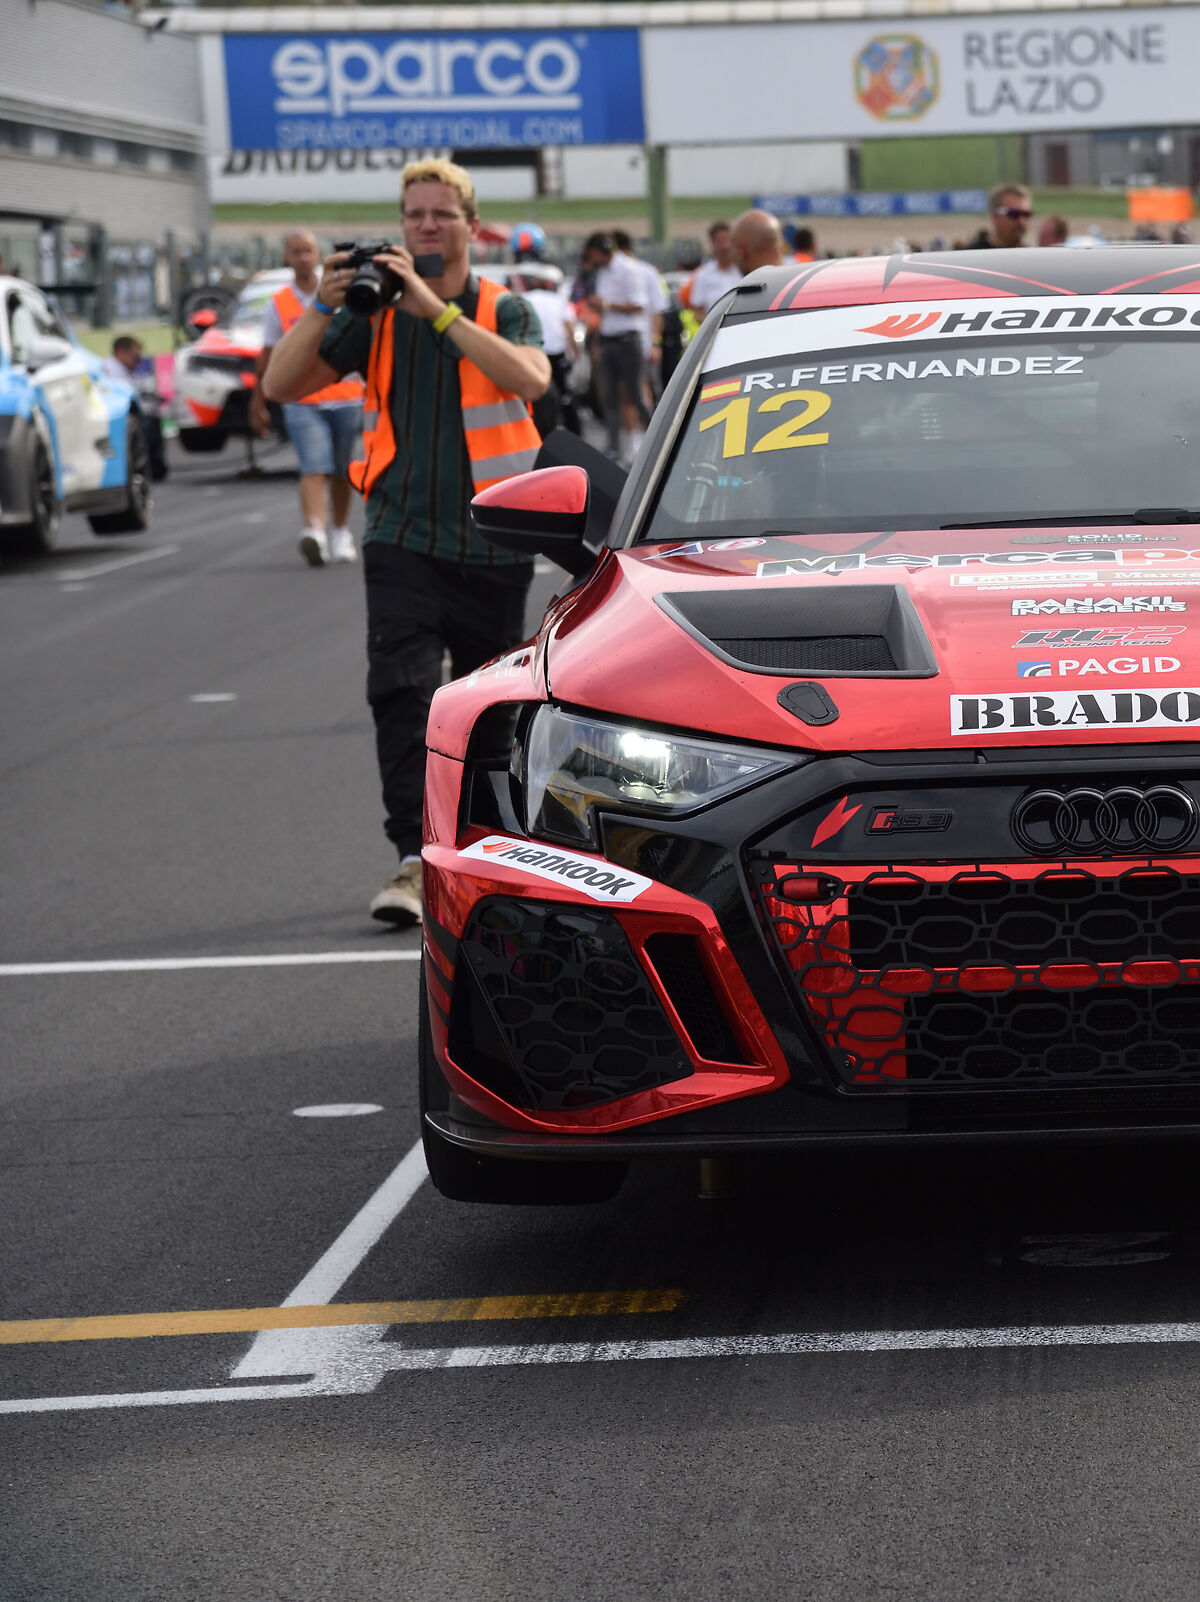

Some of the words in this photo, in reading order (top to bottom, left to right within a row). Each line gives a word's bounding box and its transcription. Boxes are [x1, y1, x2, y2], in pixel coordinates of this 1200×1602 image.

[963, 24, 1166, 70] REGIONE
[271, 37, 582, 117] sparco
[965, 72, 1104, 117] LAZIO
[743, 356, 1084, 393] R.FERNANDEZ
[699, 390, 832, 459] 12
[1058, 656, 1181, 676] PAGID
